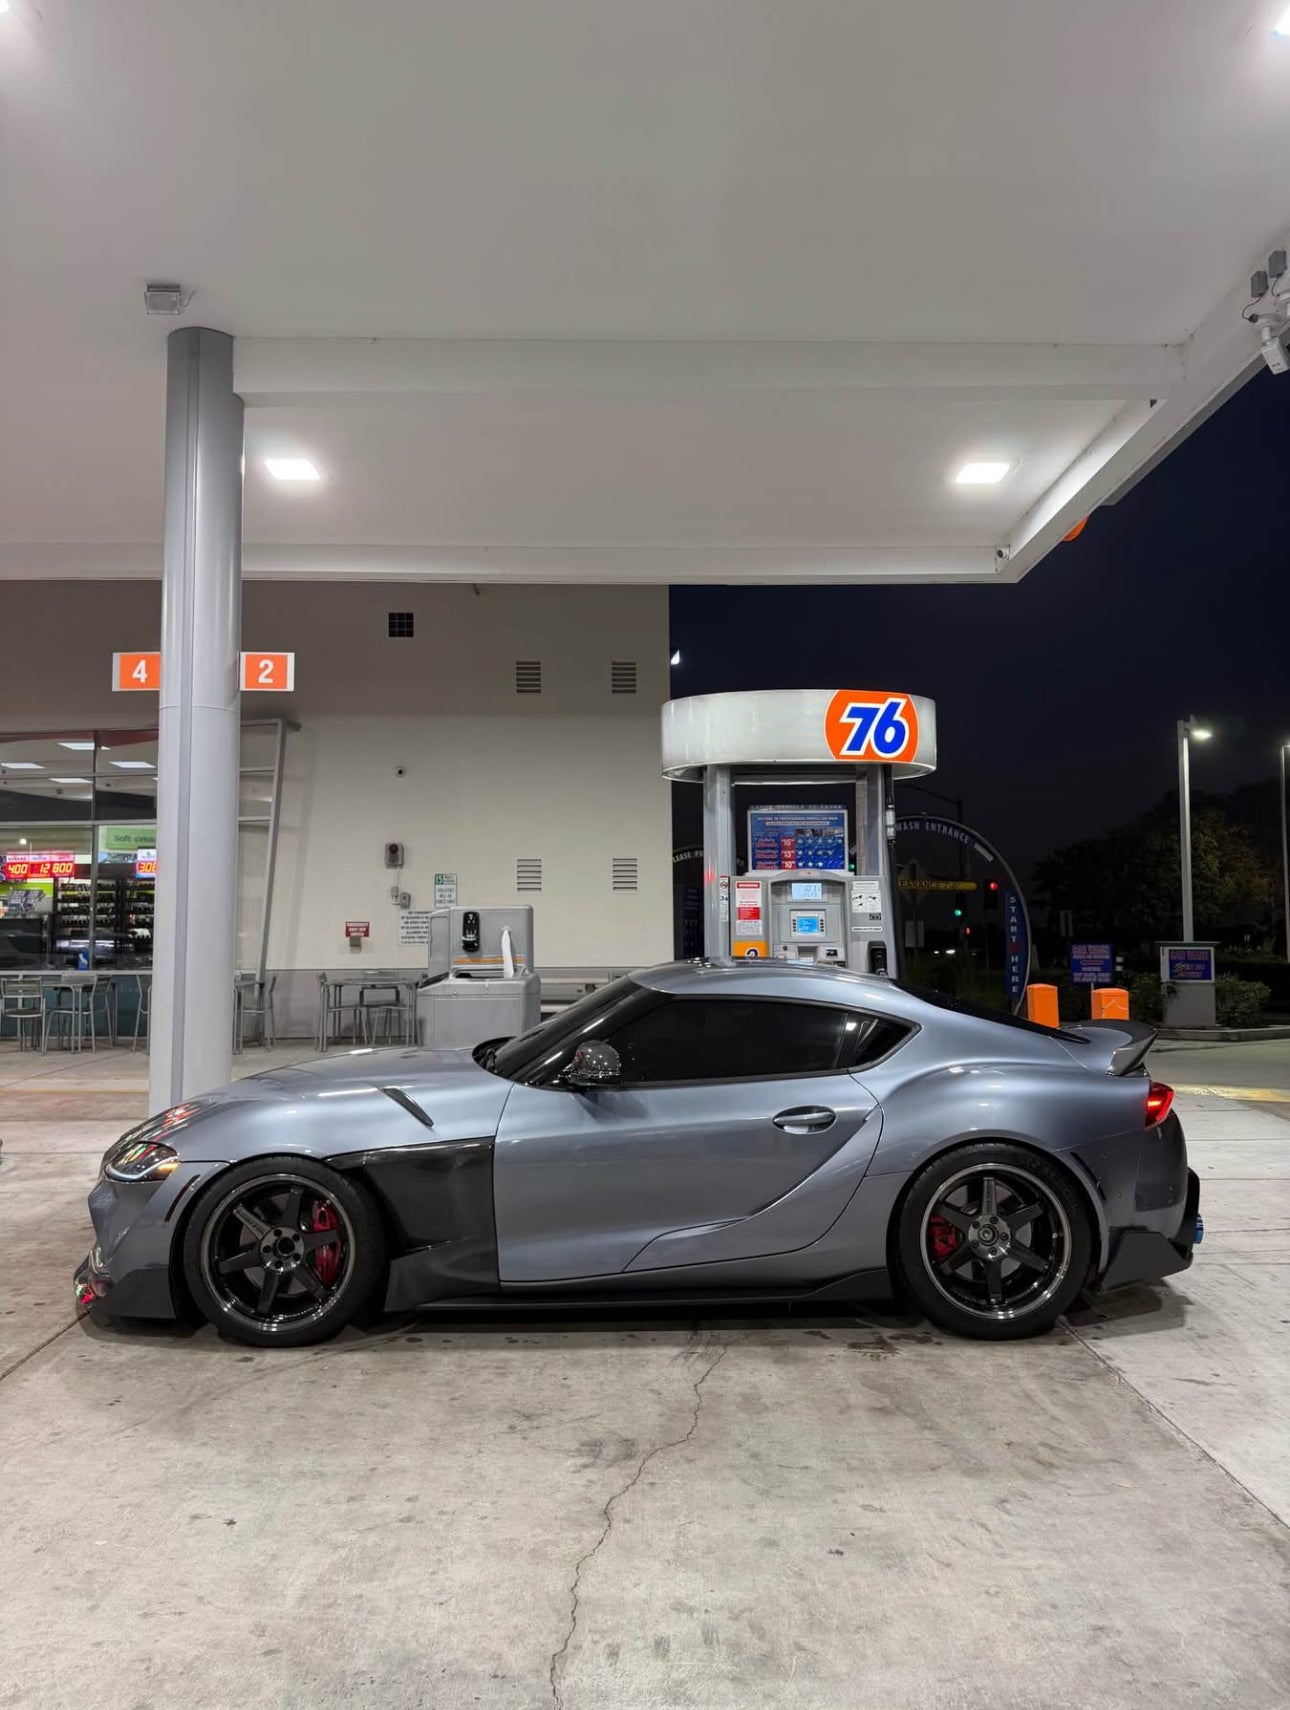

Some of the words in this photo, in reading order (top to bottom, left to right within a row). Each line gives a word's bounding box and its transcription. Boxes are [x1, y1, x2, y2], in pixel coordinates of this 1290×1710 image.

[132, 659, 147, 683] 4
[258, 659, 273, 684] 2
[840, 697, 909, 758] 76
[925, 821, 969, 844] ENTRANCE
[8, 864, 28, 874] 400
[40, 864, 50, 873] 12
[1009, 896, 1018, 943] START
[1011, 955, 1019, 993] HERE
